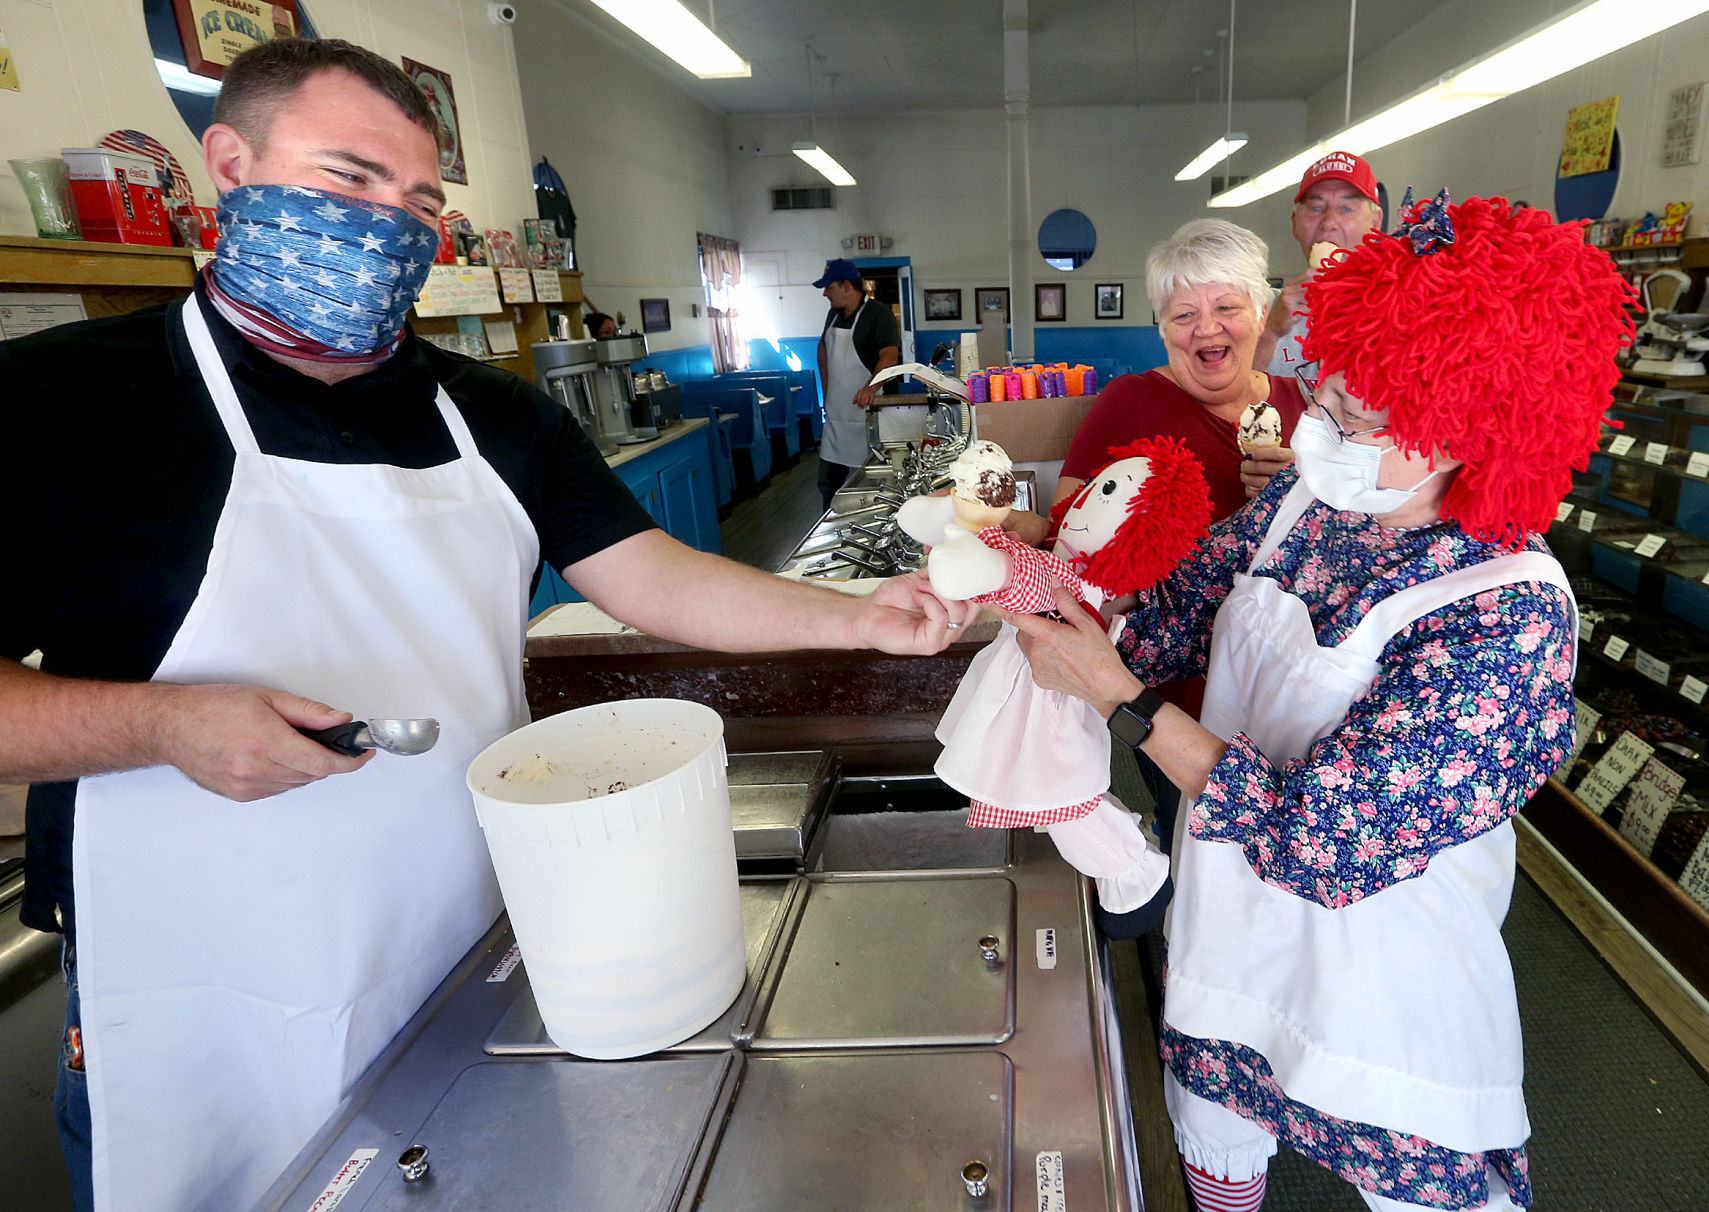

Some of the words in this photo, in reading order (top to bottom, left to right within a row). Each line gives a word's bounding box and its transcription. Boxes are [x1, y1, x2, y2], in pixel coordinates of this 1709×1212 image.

[201, 9, 221, 40] ICE
[858, 235, 875, 250] EXIT
[332, 1160, 359, 1185] Butter
